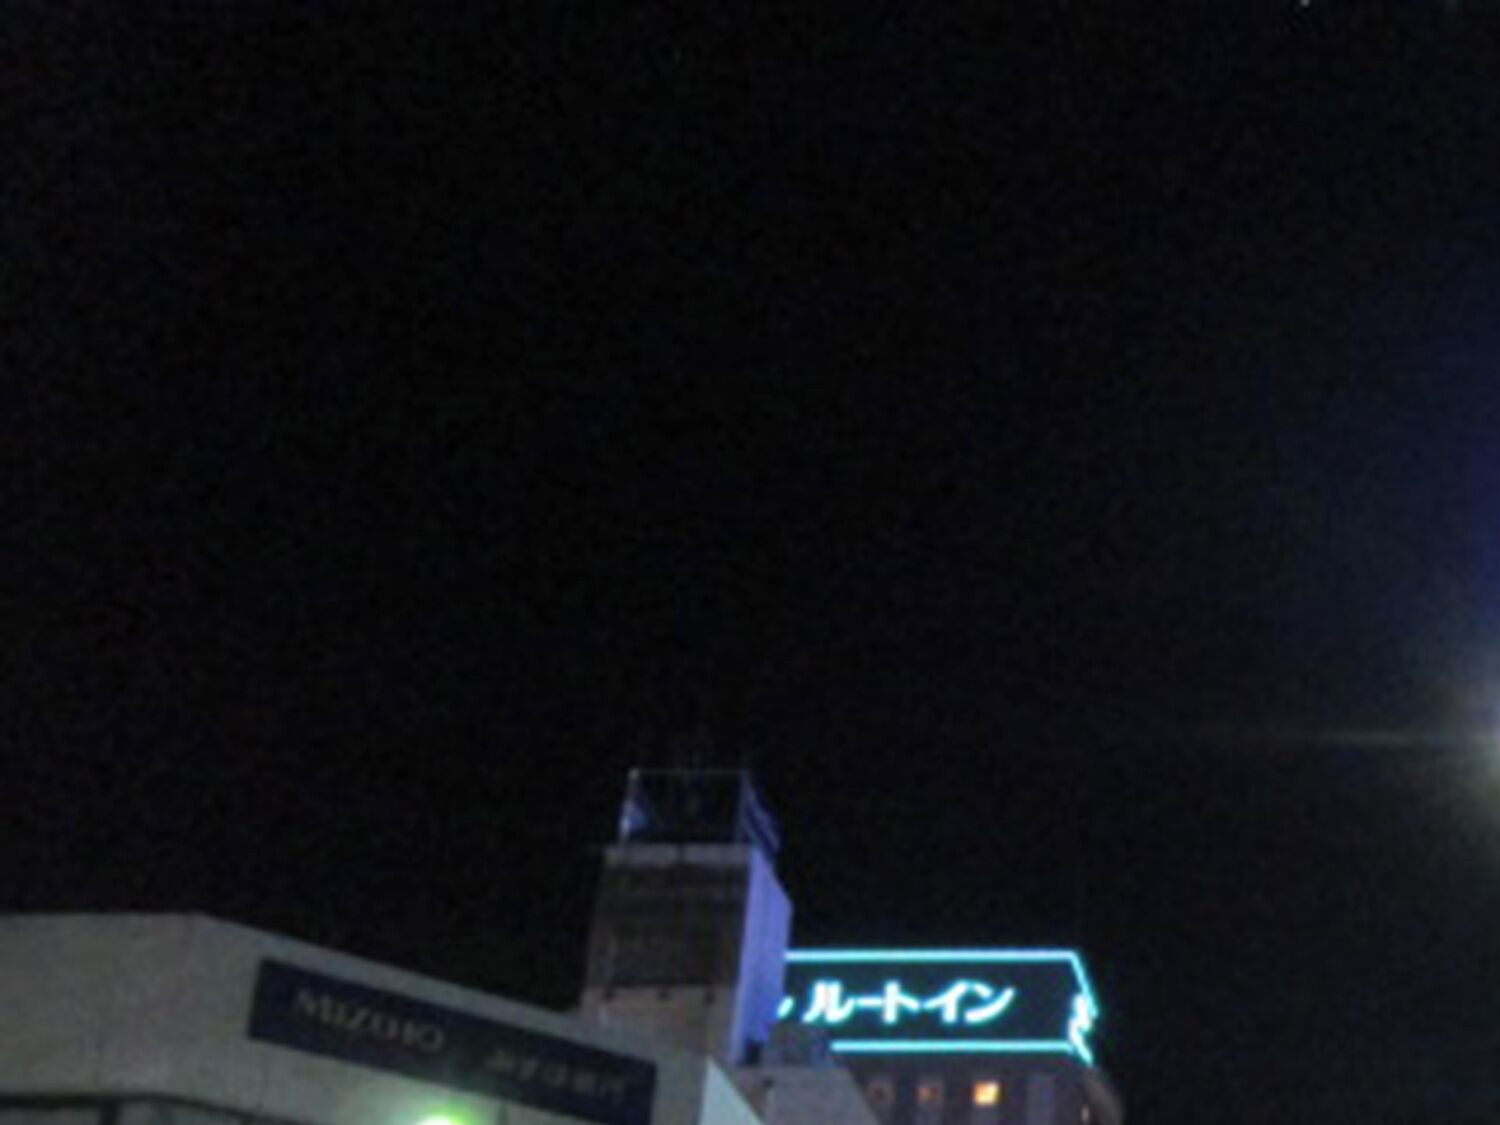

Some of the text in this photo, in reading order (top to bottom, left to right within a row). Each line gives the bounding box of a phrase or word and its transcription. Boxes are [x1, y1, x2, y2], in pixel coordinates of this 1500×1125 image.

[777, 979, 1015, 1024] ルートイン
